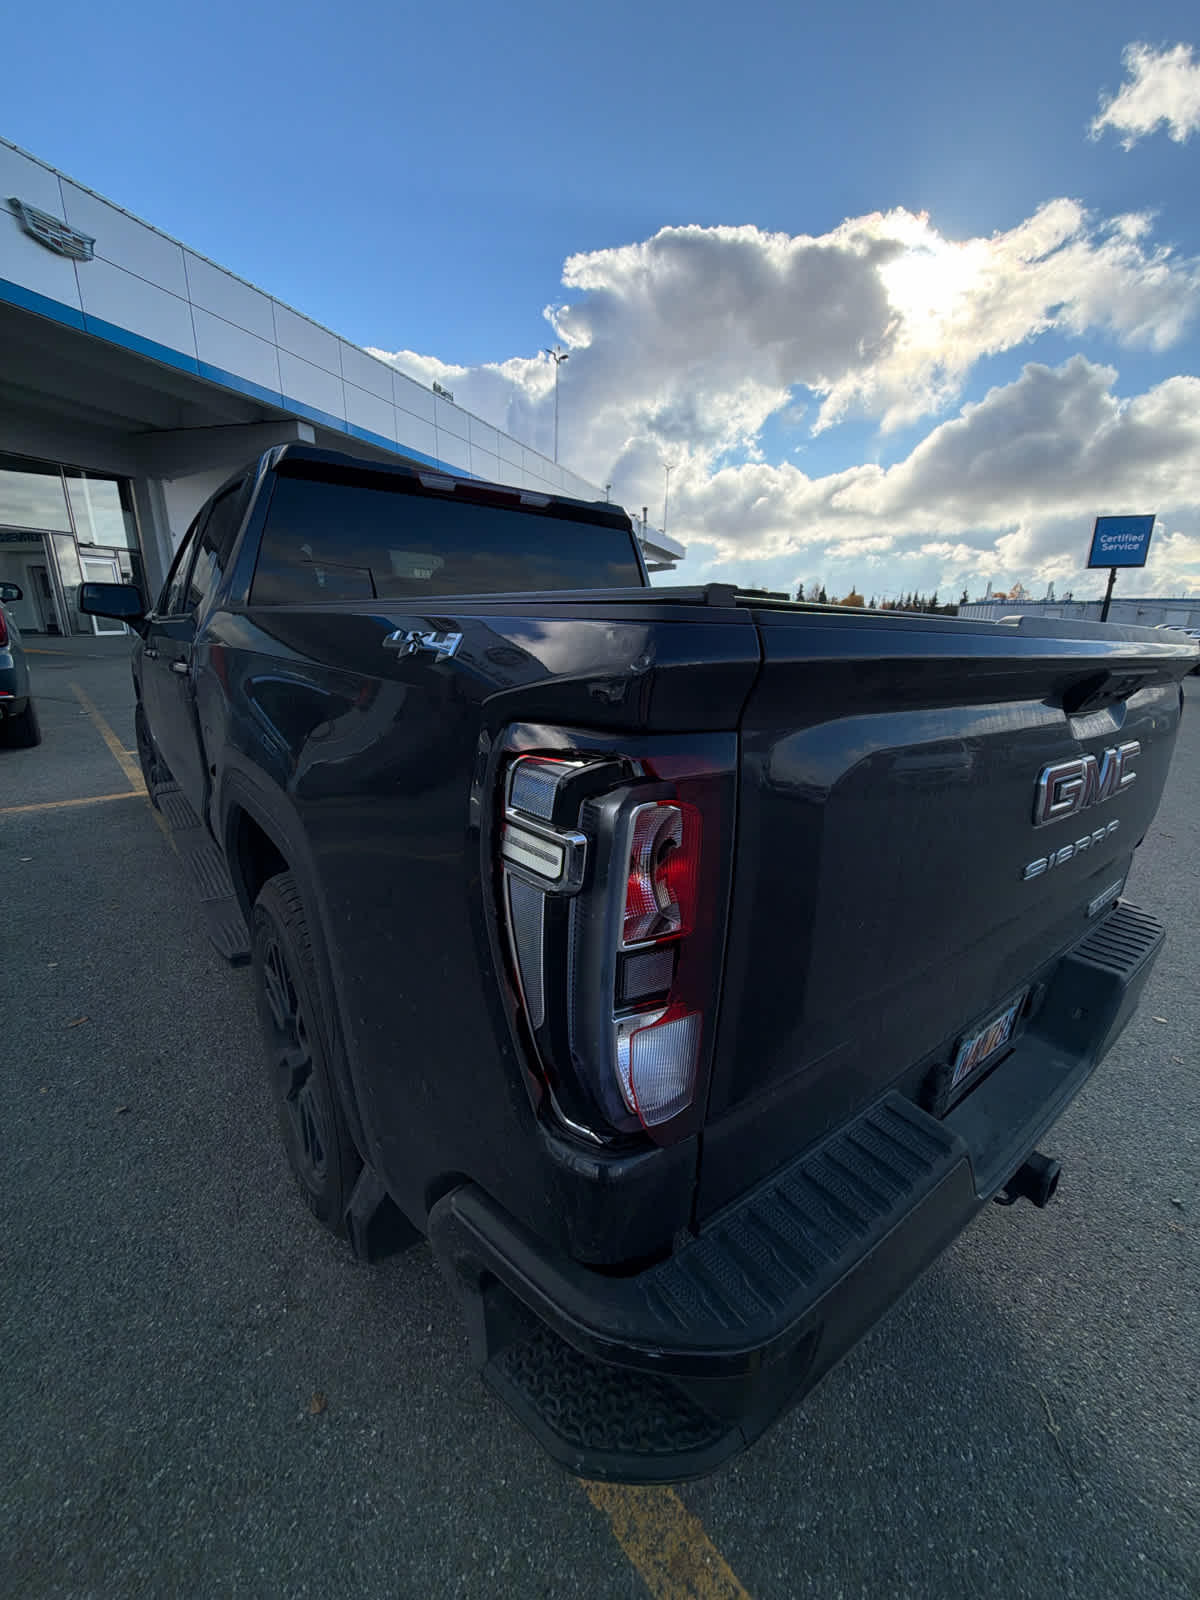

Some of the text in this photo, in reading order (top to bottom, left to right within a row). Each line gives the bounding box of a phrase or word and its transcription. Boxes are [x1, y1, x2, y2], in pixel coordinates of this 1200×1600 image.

[1100, 533, 1145, 543] Certified
[1101, 542, 1140, 551] Service
[1032, 740, 1141, 829] GMC
[1023, 819, 1120, 880] SIERRA
